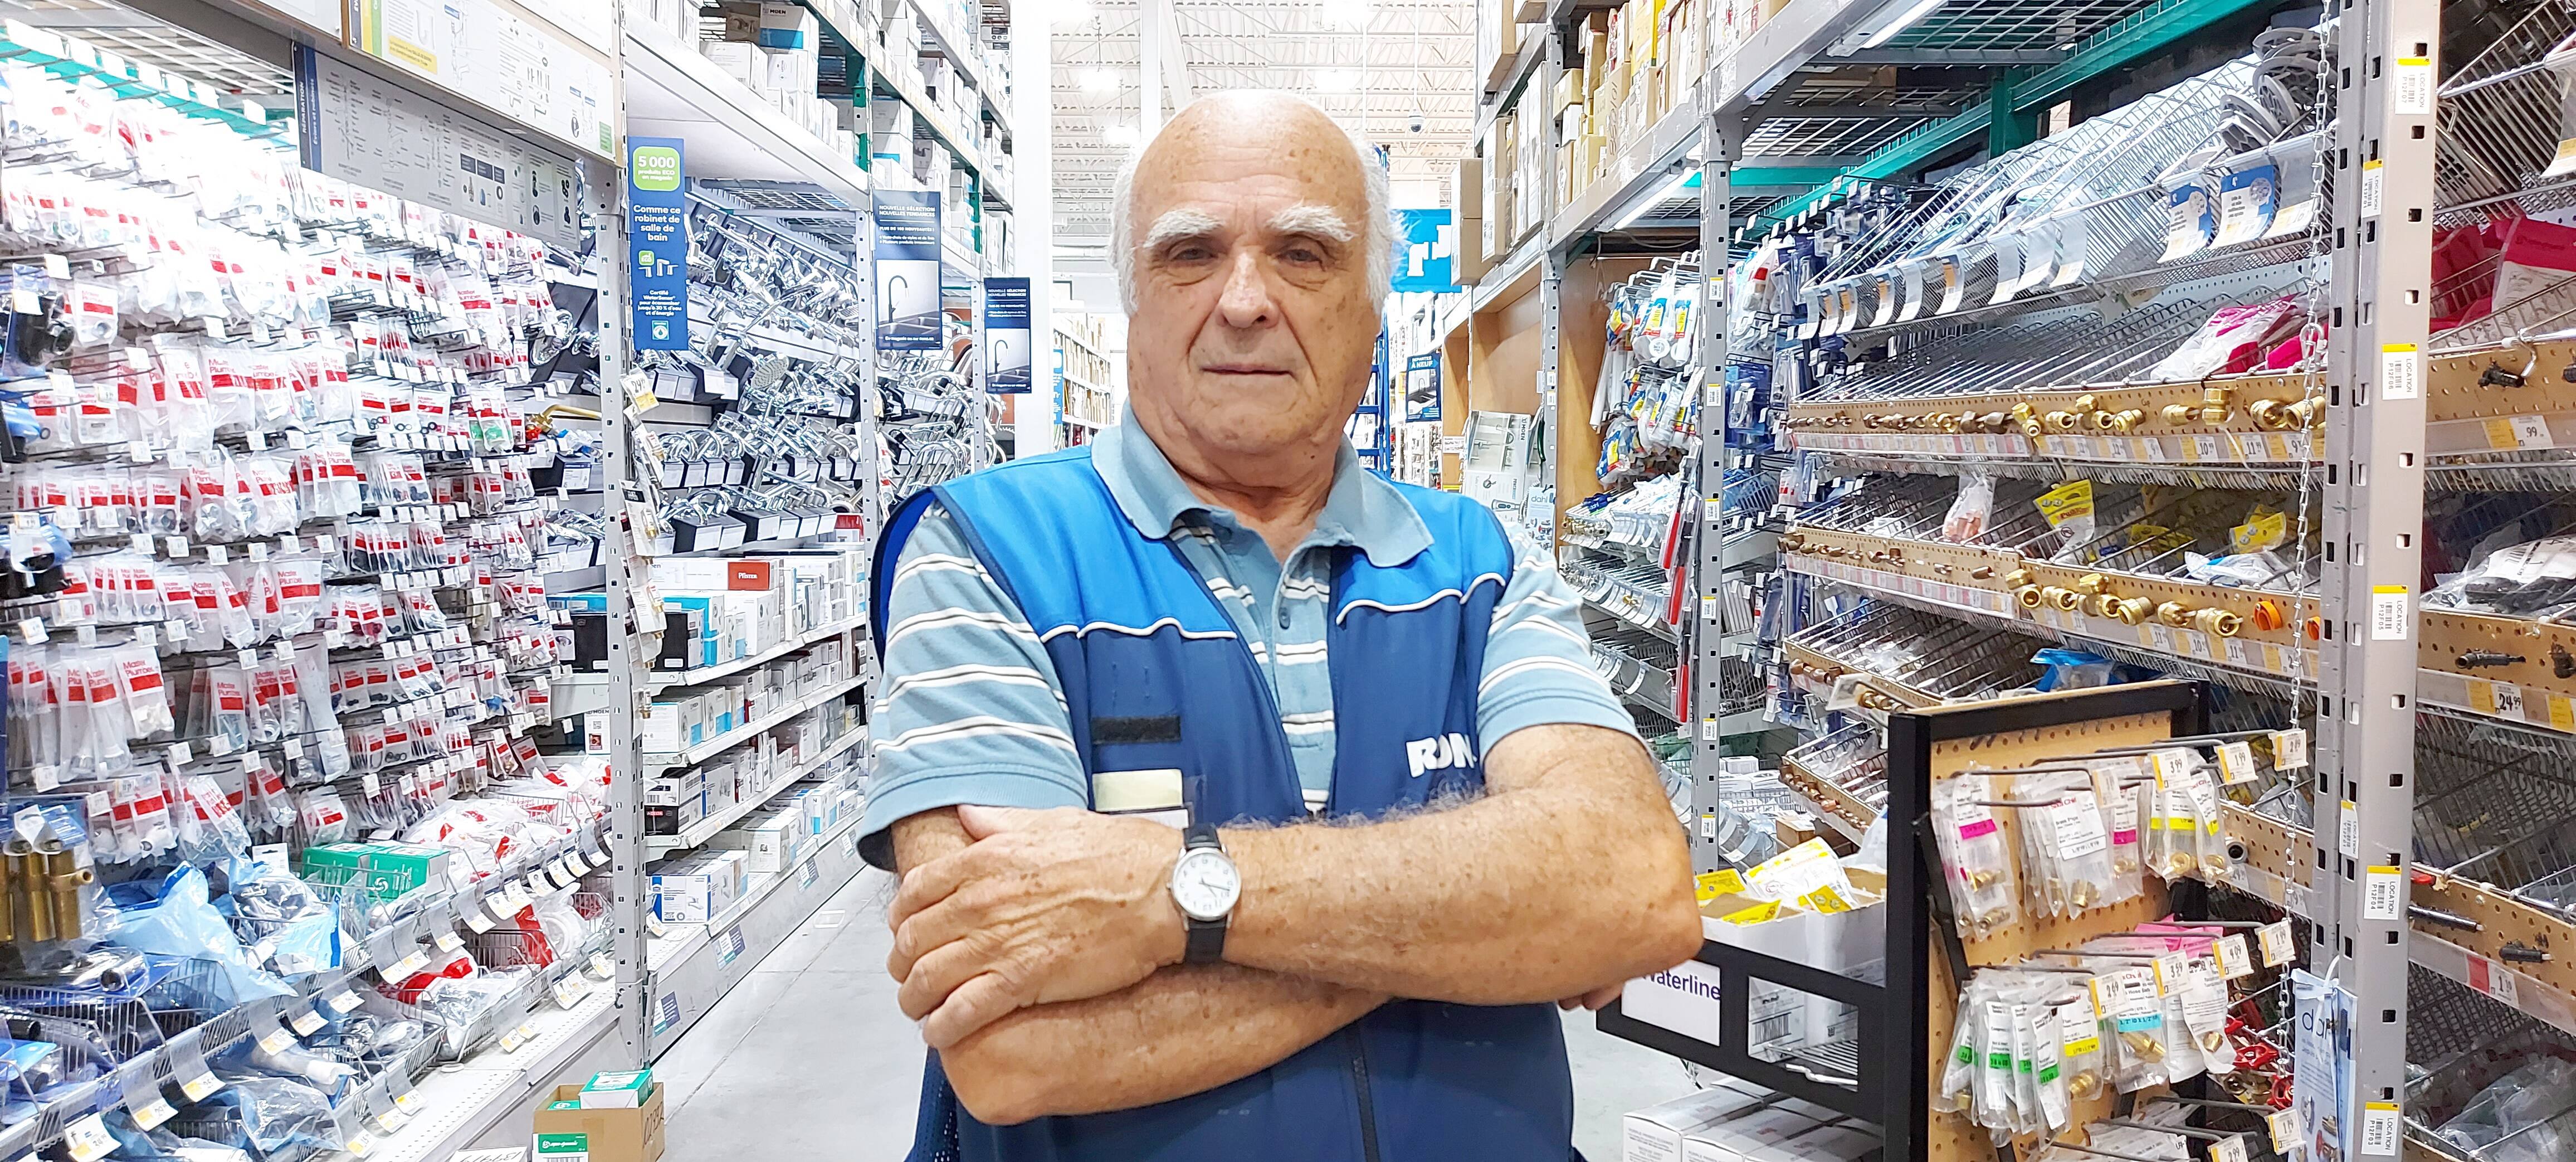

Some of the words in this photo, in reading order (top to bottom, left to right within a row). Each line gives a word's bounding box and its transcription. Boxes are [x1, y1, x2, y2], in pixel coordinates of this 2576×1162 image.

[638, 155, 647, 167] 5
[648, 156, 675, 169] 000
[633, 205, 669, 214] Comme
[635, 214, 667, 223] robinet
[668, 215, 680, 223] de
[647, 232, 669, 241] bain
[1531, 495, 1548, 503] dahl
